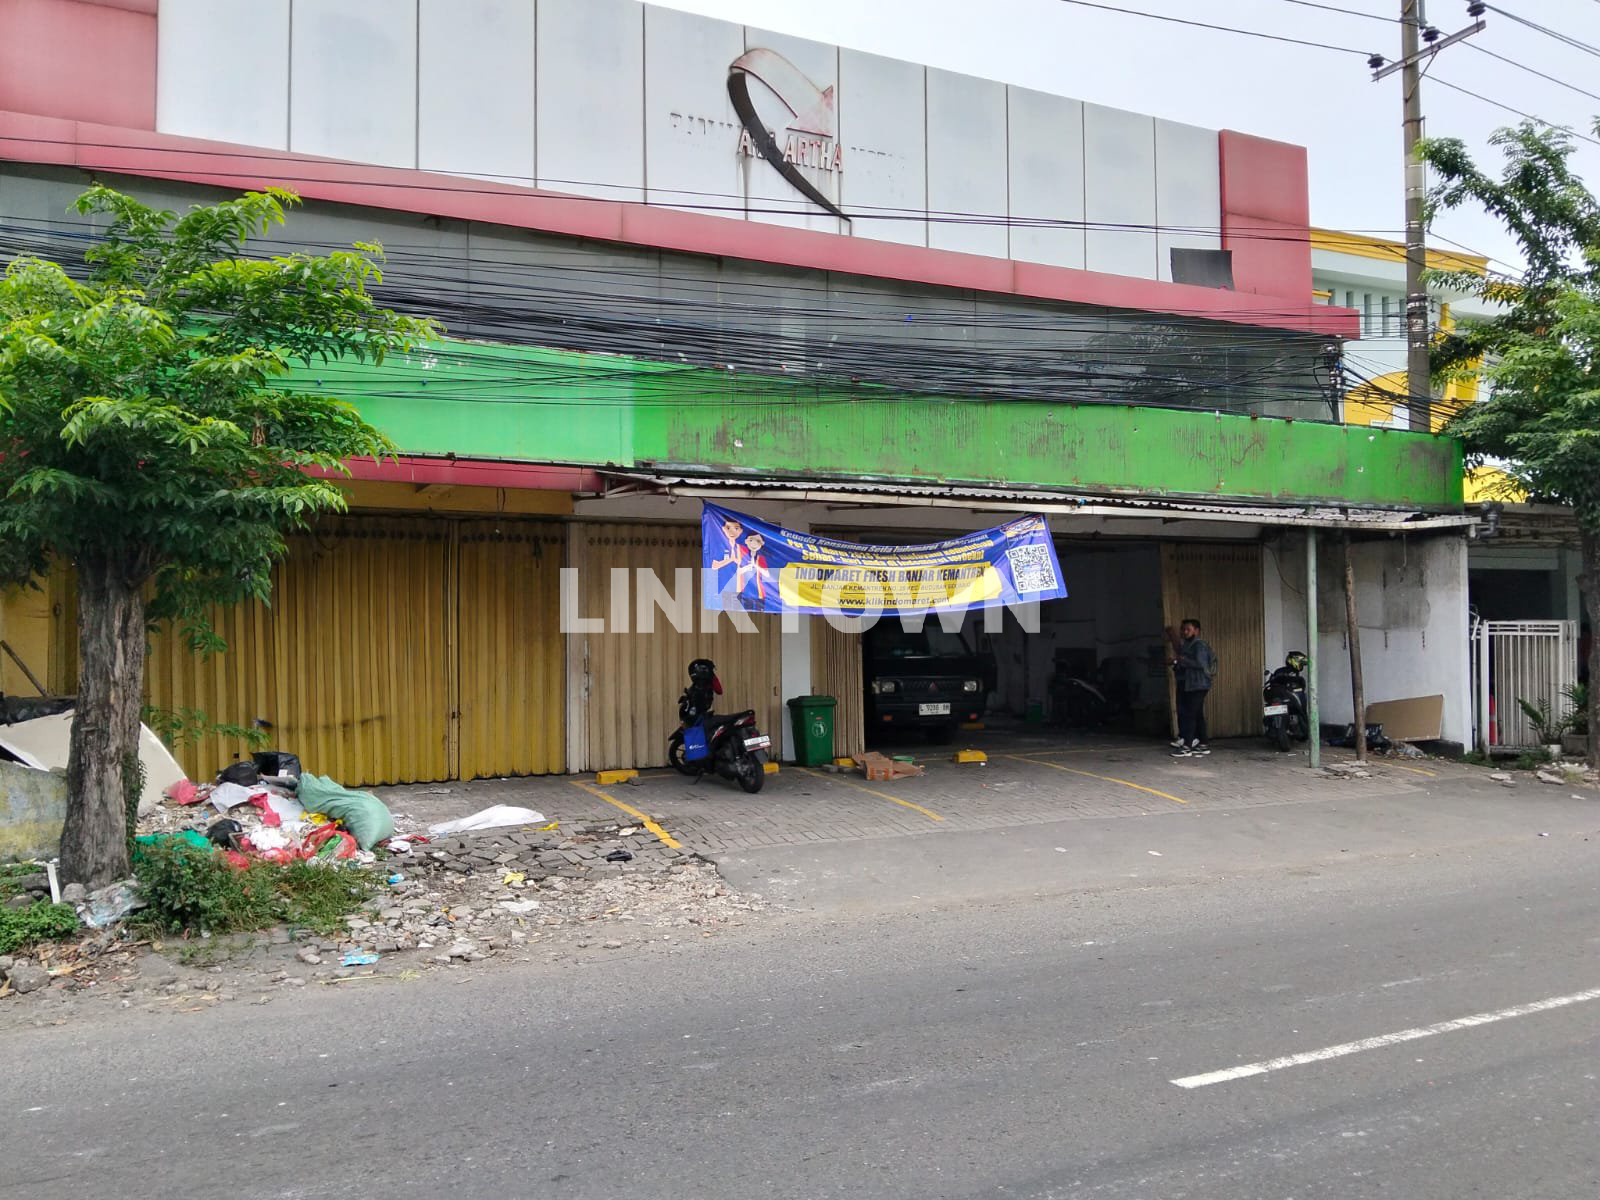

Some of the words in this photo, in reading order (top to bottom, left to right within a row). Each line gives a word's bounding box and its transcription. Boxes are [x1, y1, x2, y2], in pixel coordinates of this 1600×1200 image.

[783, 134, 844, 173] ARTHA
[795, 567, 863, 582] INDOMARET
[863, 569, 897, 582] FRESH
[898, 568, 934, 582] BANJAR
[938, 565, 985, 581] KEMANTREN
[838, 596, 949, 606] www.klikindomaret.com
